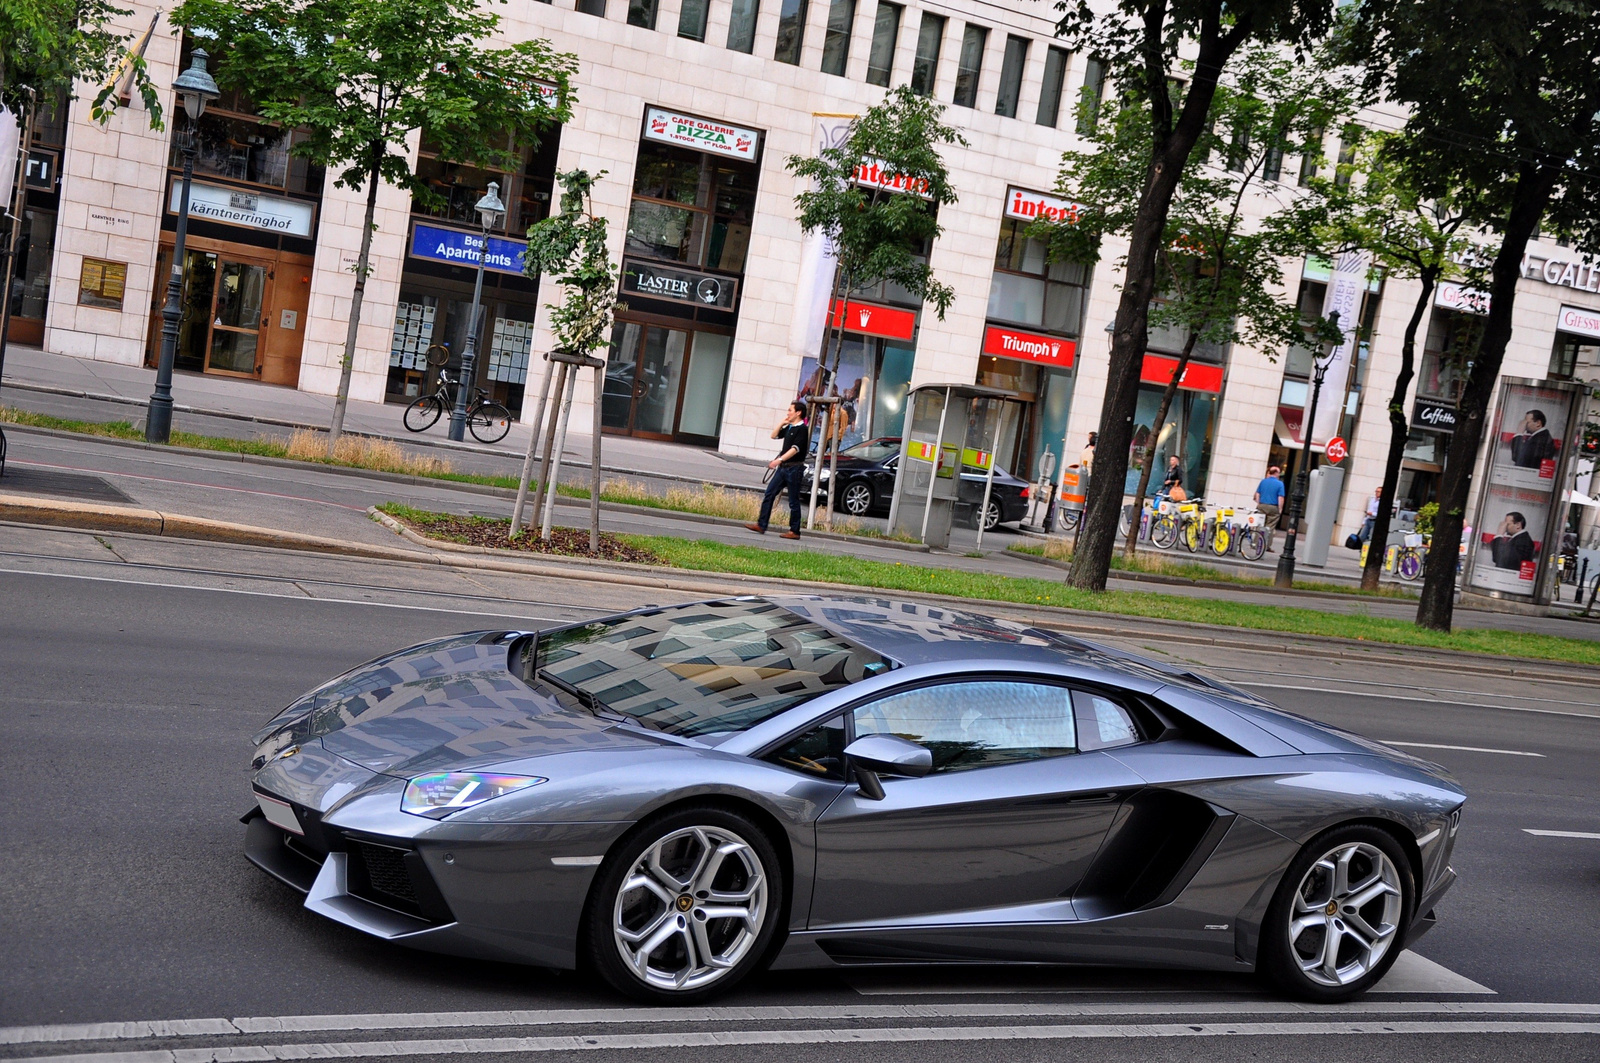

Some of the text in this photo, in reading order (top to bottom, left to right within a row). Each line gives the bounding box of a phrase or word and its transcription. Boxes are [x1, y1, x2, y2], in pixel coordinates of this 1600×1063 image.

[671, 116, 735, 136] CAFE GALERIE
[676, 124, 726, 144] PIZZA
[711, 142, 732, 151] FLOOR
[190, 202, 292, 229] kärntnerringhof
[1012, 191, 1084, 226] interi
[117, 217, 130, 225] RING
[464, 235, 484, 248] Bes
[435, 242, 511, 267] Apartments
[637, 273, 689, 294] LASTER
[1001, 335, 1050, 358] Triumph
